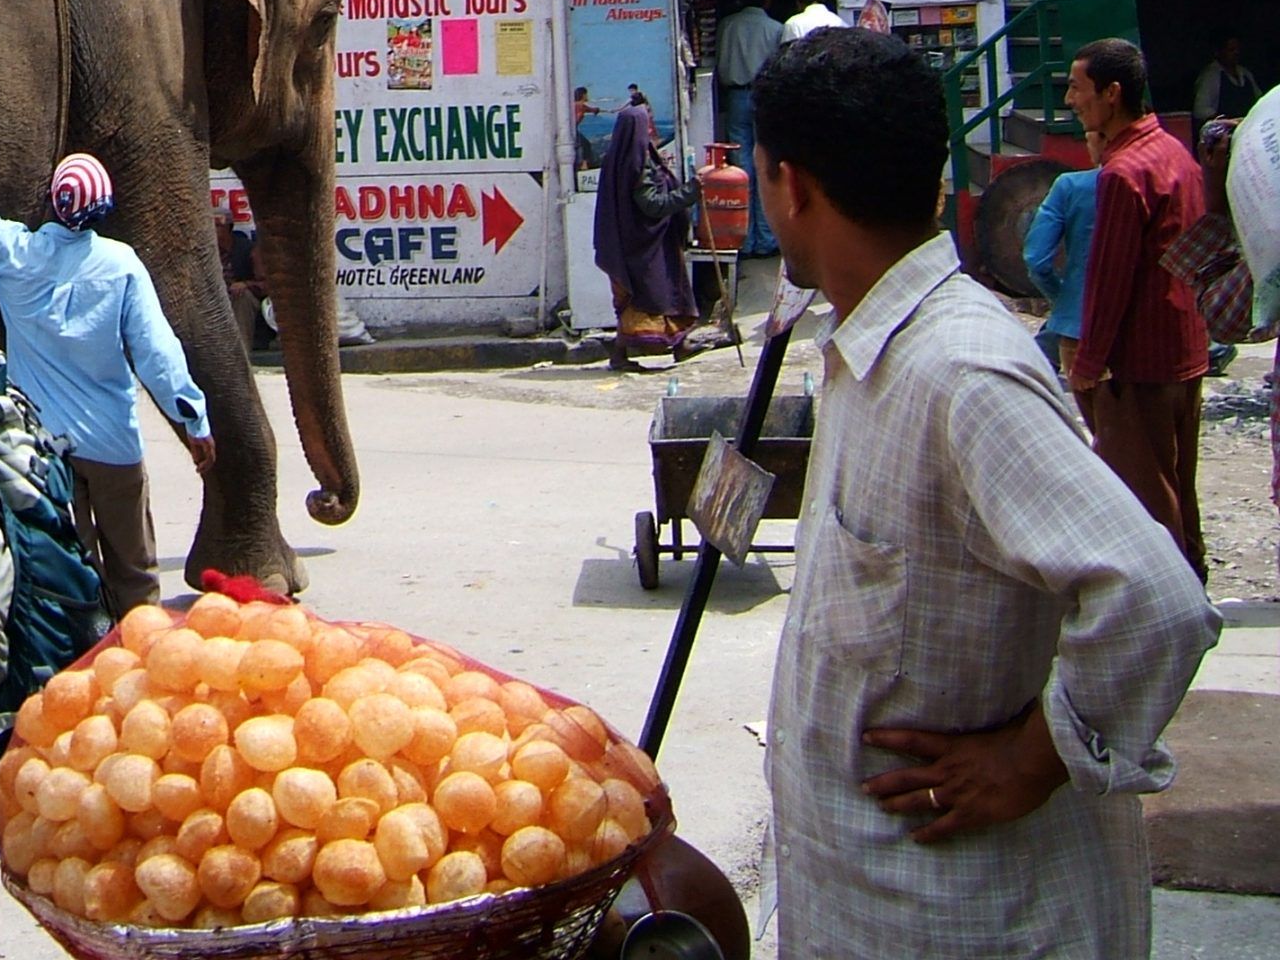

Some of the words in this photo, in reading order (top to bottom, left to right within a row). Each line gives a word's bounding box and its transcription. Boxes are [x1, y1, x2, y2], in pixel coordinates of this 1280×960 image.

[334, 50, 380, 78] urs
[373, 104, 523, 163] EXCHANGE
[335, 226, 458, 266] CAFE
[335, 268, 386, 287] HOTEL
